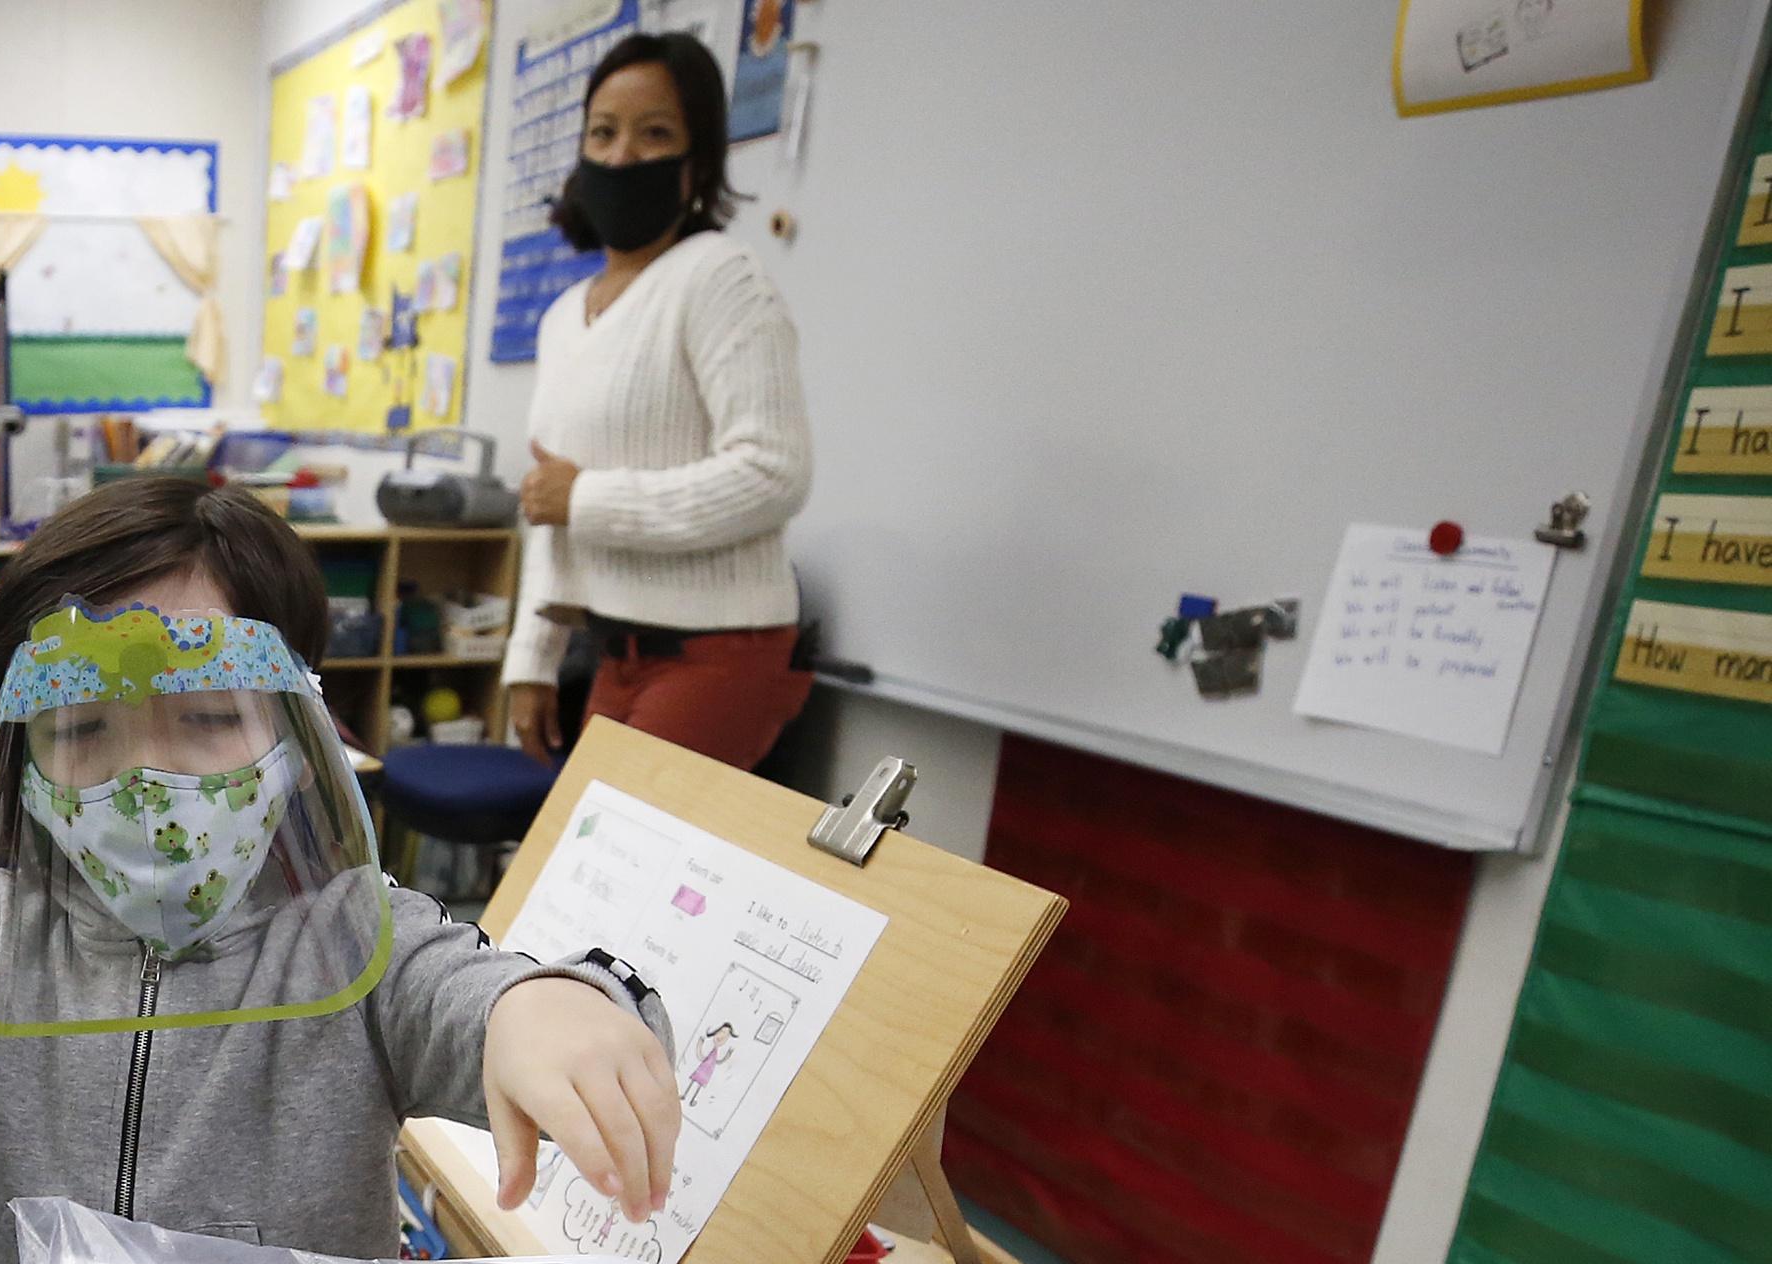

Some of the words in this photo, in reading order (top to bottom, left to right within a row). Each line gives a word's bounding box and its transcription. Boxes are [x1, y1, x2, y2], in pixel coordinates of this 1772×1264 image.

[1725, 287, 1751, 338] I
[1685, 408, 1711, 456] I
[1661, 517, 1680, 561] I
[1701, 519, 1772, 569] have
[1633, 622, 1688, 672] How
[747, 900, 756, 914] I
[756, 905, 774, 924] like
[777, 917, 789, 931] to
